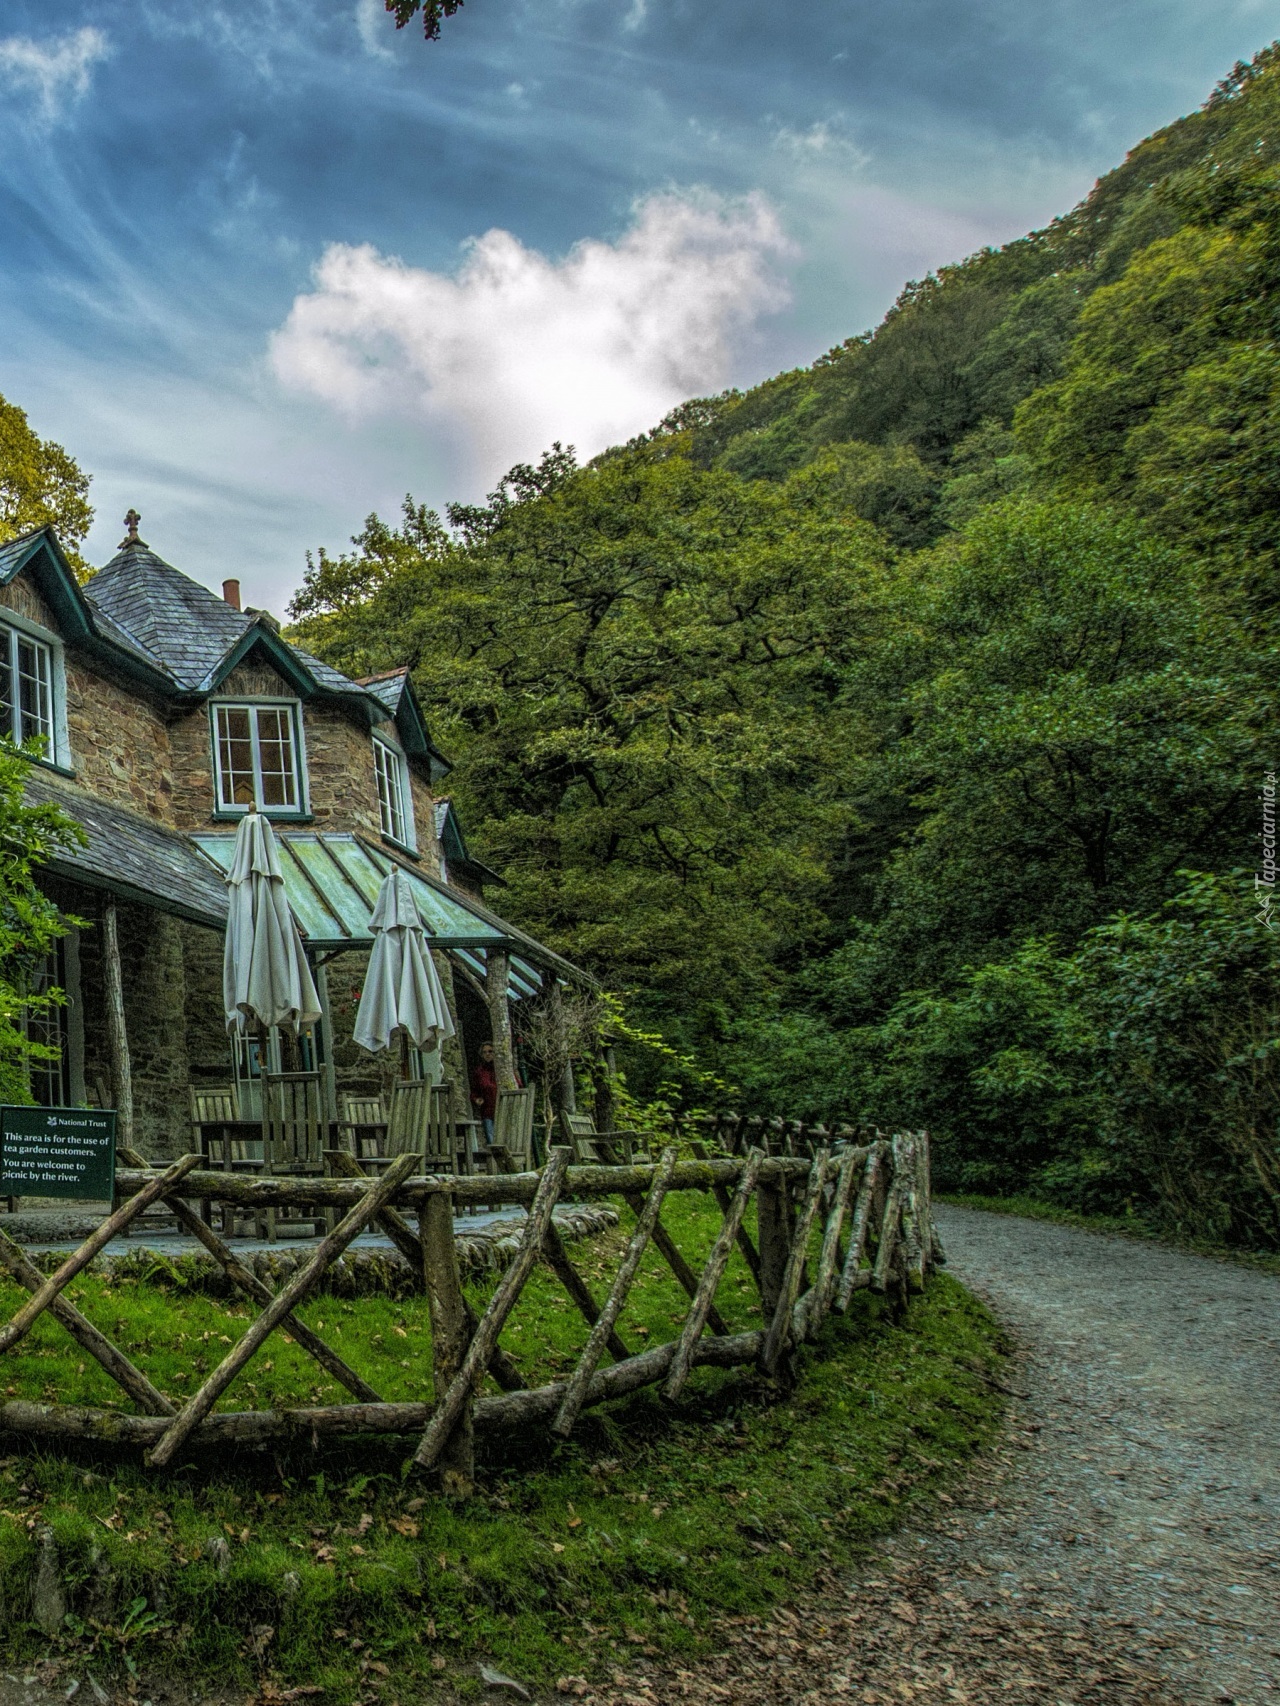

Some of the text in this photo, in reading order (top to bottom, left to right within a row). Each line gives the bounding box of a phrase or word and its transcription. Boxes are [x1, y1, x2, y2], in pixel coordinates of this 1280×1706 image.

[58, 1118, 87, 1126] National
[5, 1132, 22, 1141] This
[44, 1134, 51, 1143] is
[53, 1135, 66, 1143] for
[67, 1136, 81, 1144] the
[99, 1137, 110, 1145] of
[3, 1145, 96, 1156] tea garden customers.
[3, 1158, 19, 1167] You
[37, 1161, 74, 1170] welcome
[29, 1171, 40, 1181] by
[42, 1172, 56, 1181] the
[58, 1173, 80, 1182] river.
